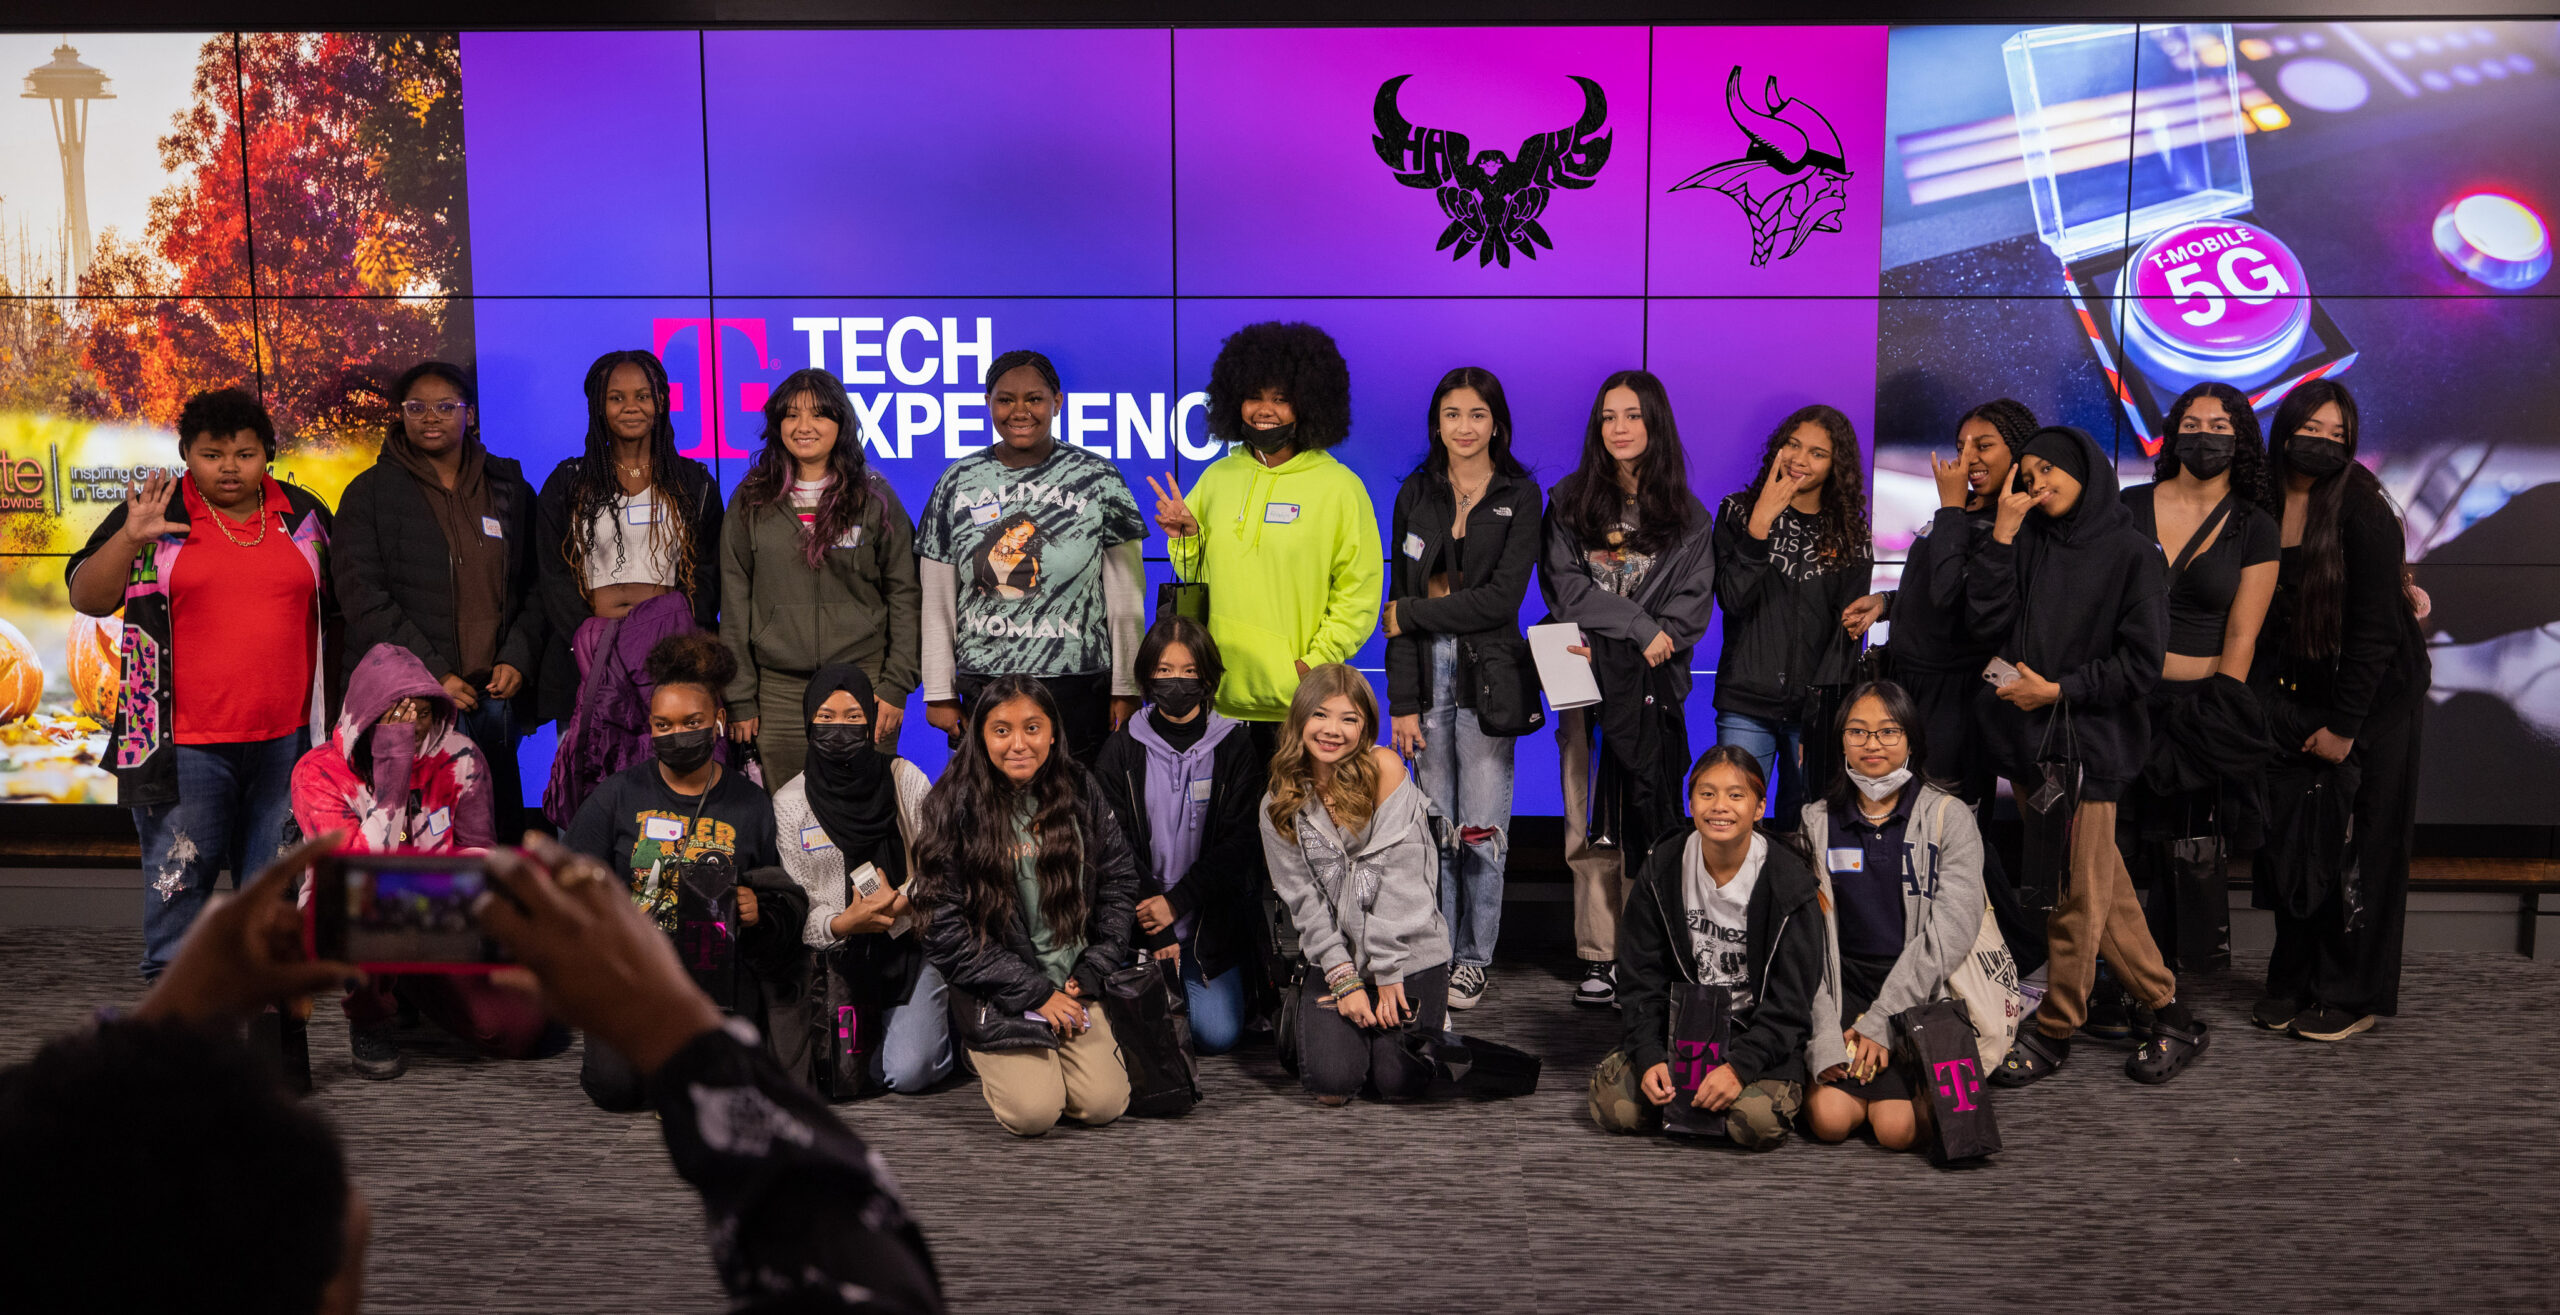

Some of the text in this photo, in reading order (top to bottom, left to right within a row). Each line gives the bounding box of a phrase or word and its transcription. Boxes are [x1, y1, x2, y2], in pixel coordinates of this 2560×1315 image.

[2148, 228, 2254, 269] T-MOBILE
[2164, 246, 2290, 327] 5G
[793, 315, 993, 386] TECH
[70, 465, 130, 482] Inspiring
[0, 497, 43, 509] DWIDE
[72, 485, 85, 499] In
[954, 481, 1089, 514] AALIYAH
[965, 608, 1080, 638] WOMAN
[636, 810, 736, 848] TLER
[1933, 1058, 1981, 1113] T
